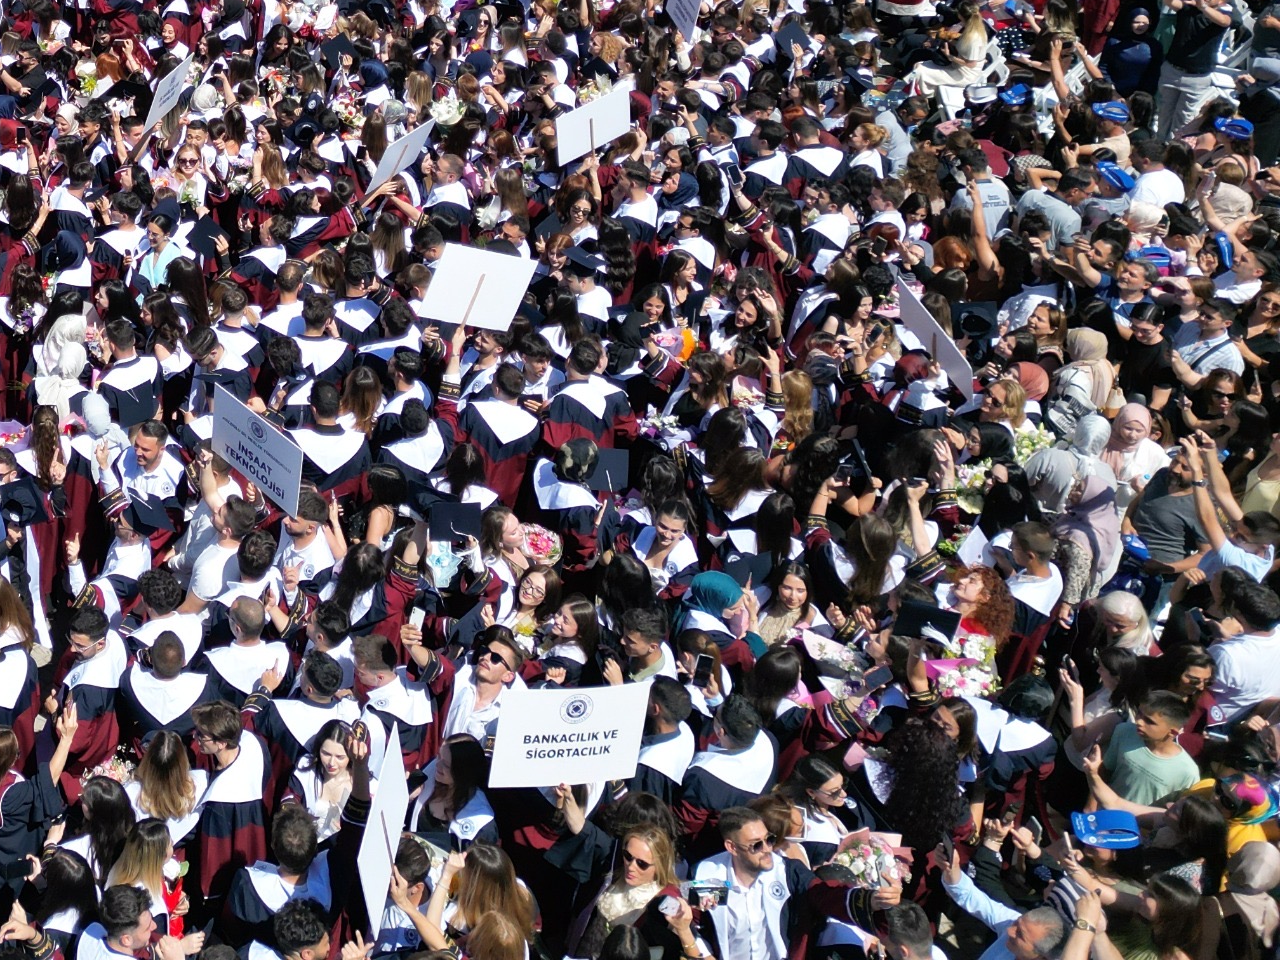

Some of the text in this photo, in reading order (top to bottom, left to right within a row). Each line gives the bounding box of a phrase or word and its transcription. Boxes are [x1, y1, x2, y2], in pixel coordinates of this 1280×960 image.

[238, 440, 273, 476] İNŞAAT
[224, 443, 285, 500] TEKNOLOJİSİ
[523, 729, 619, 744] BANKACILIK VE
[526, 745, 611, 759] SİGORTACILIK
